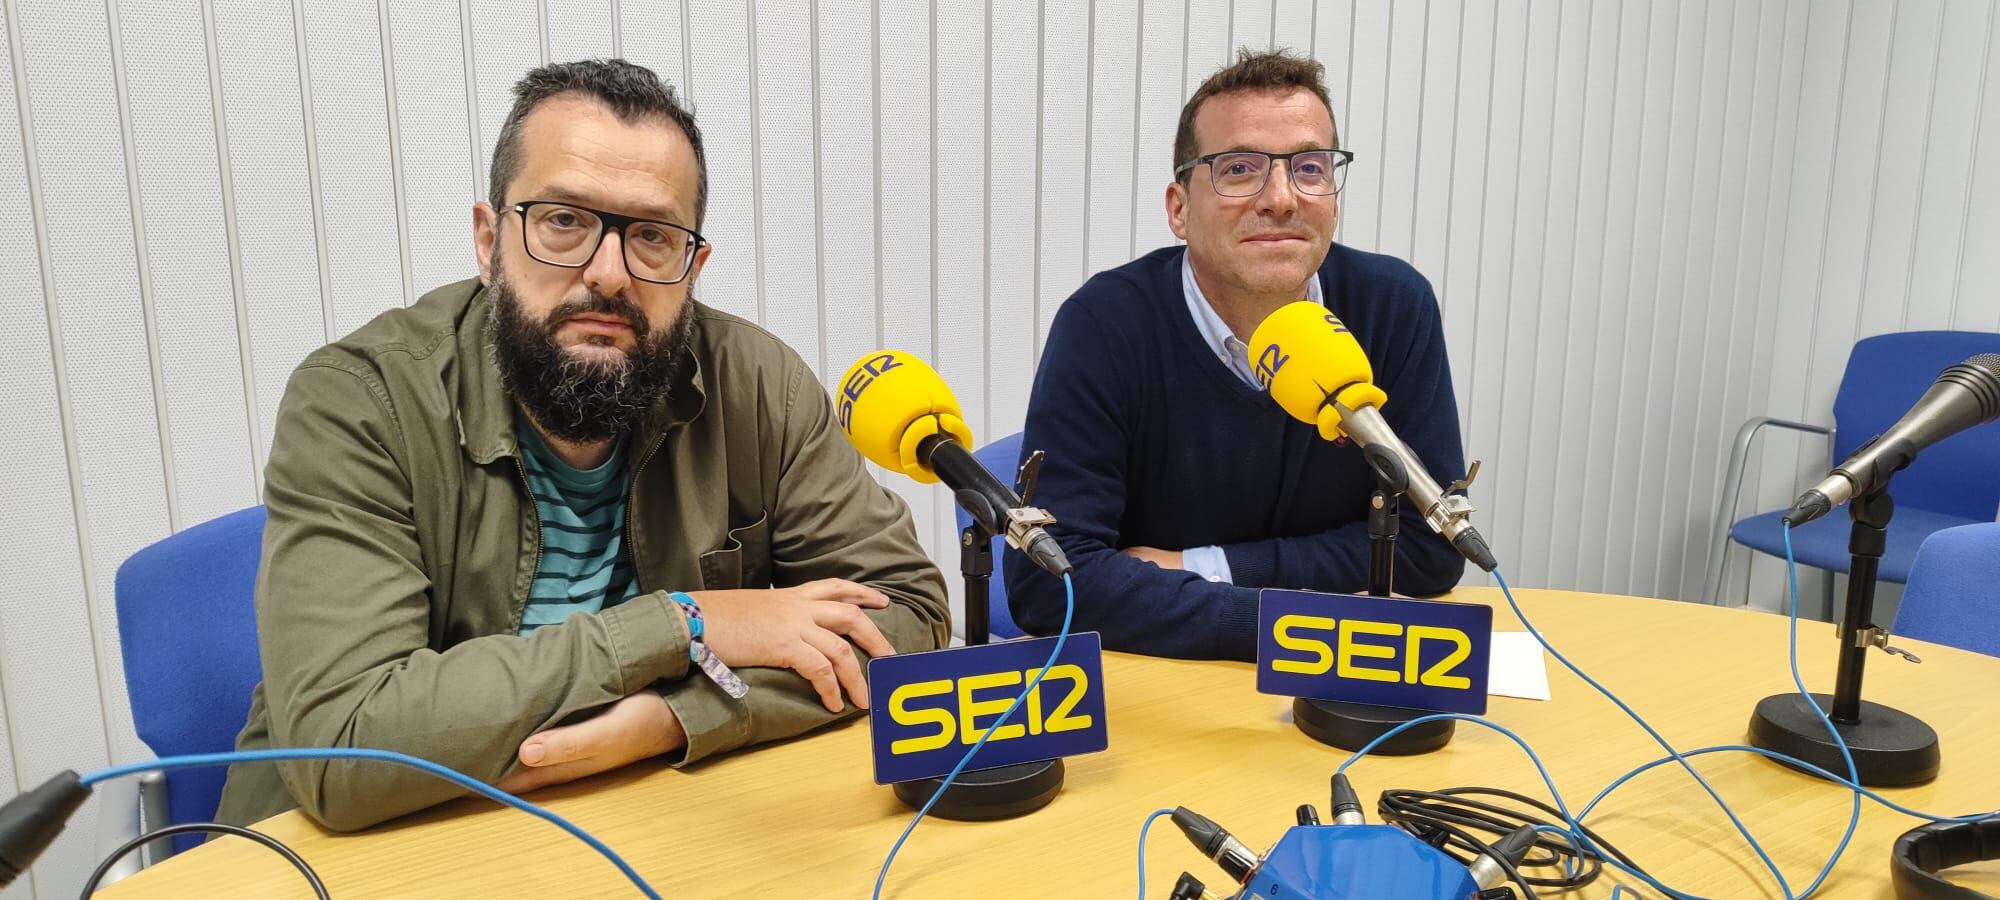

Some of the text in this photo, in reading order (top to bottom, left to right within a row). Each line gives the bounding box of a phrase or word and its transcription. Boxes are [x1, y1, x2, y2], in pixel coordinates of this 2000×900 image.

[838, 355, 903, 436] SER
[1271, 614, 1472, 690] SER
[889, 665, 1092, 754] SER
[1270, 883, 1279, 896] 6
